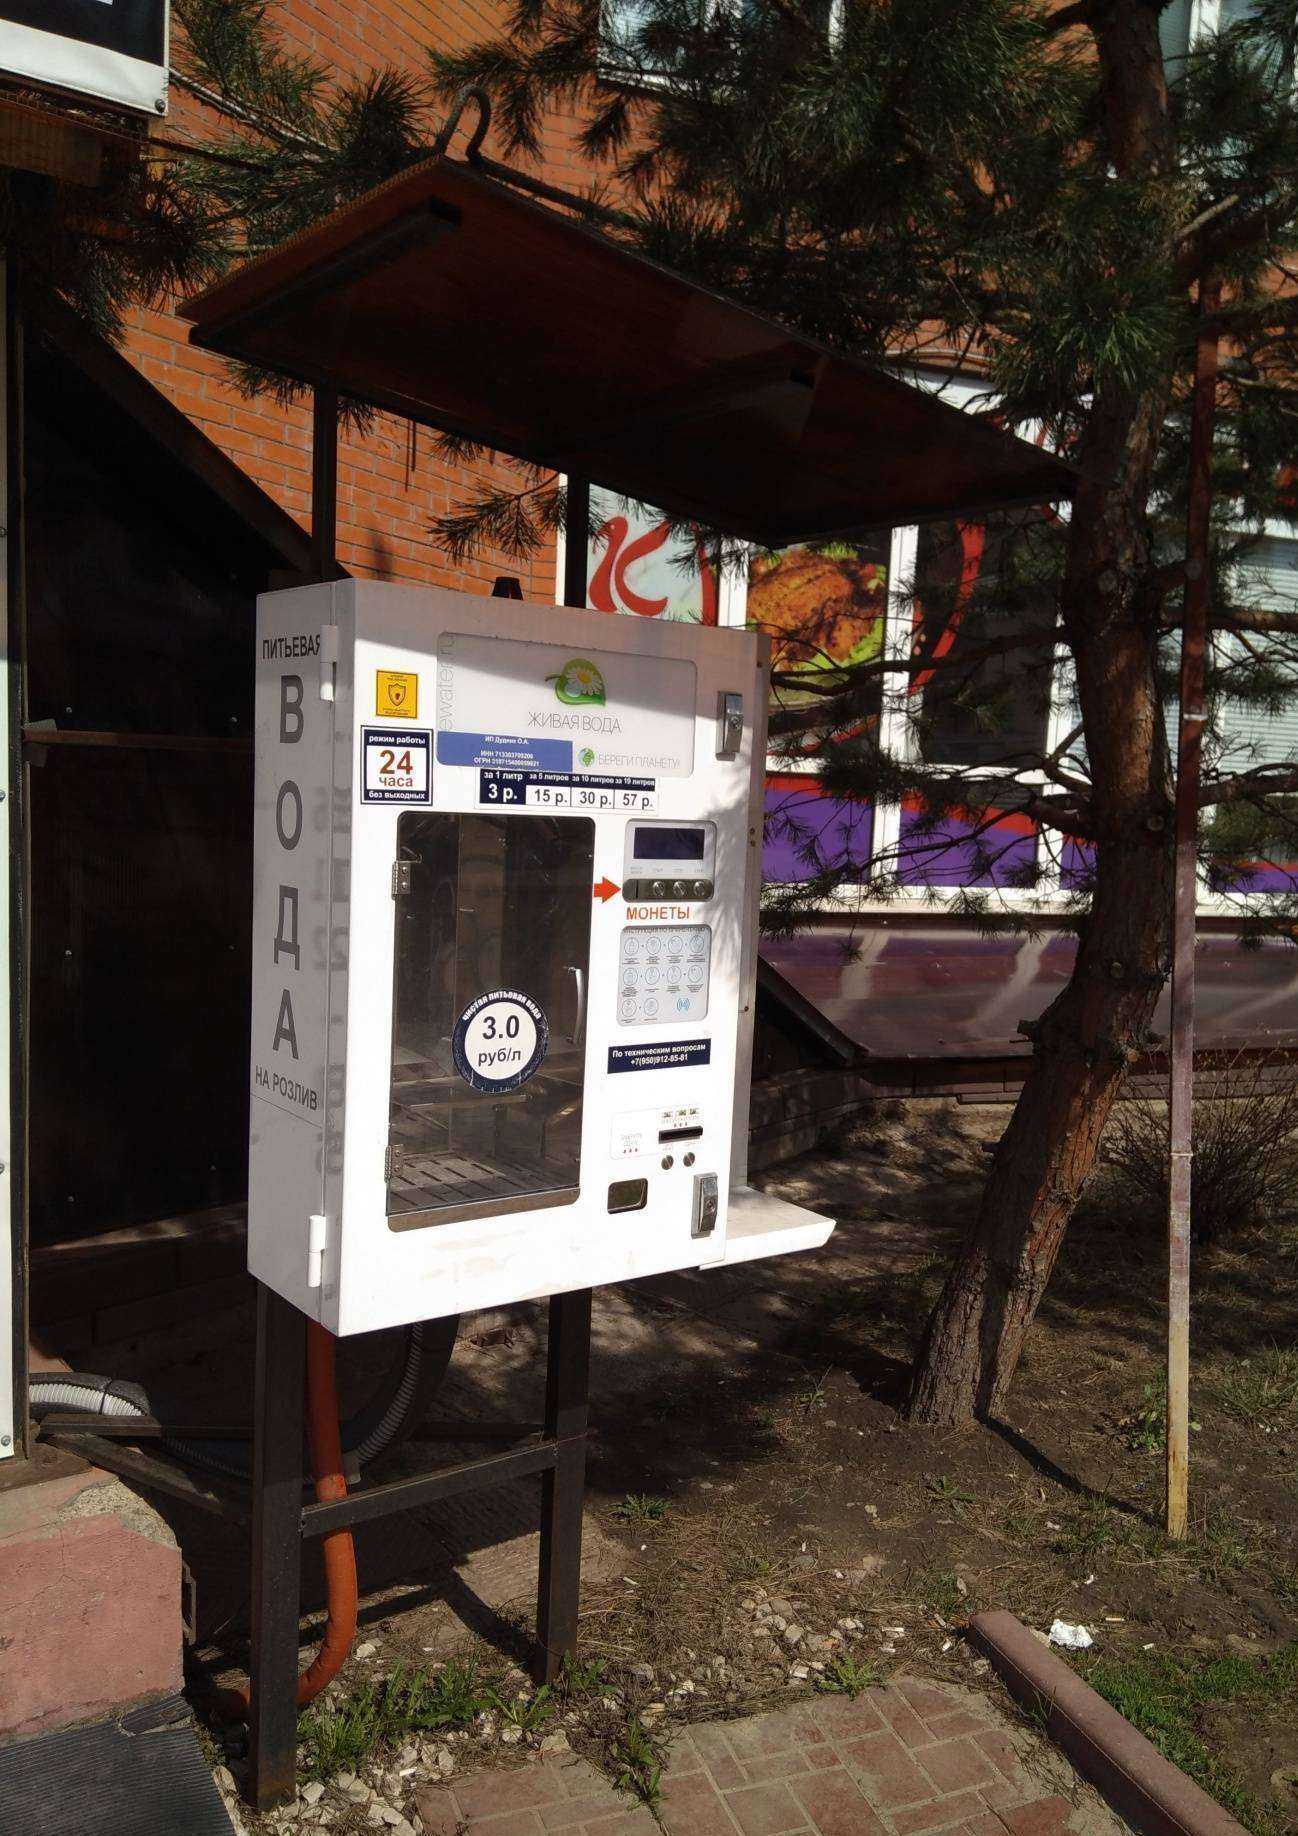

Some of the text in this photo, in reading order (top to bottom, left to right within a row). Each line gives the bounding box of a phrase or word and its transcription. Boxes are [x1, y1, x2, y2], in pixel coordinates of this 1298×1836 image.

[262, 634, 321, 660] ПИТЬЕВАЯ
[527, 711, 622, 735] ЖИВАЯ ВОДА
[368, 735, 426, 745] режим работы
[379, 749, 413, 775] 24
[379, 777, 413, 787] часа
[502, 772, 524, 781] литр
[544, 774, 569, 782] литров
[590, 776, 614, 785] литров
[624, 777, 631, 785] 19
[632, 778, 655, 787] литров
[368, 790, 426, 800] без выходных
[488, 783, 518, 802] 3 р.
[534, 788, 568, 806] 15 р.
[580, 790, 612, 808] 30 р.
[622, 793, 653, 810] 57 р.
[272, 675, 304, 1060] ВОДА
[626, 906, 690, 920] МОНЕТЫ
[488, 990, 528, 1004] питьевая
[525, 1000, 542, 1020] вода
[482, 1014, 520, 1040] 3.0
[478, 1047, 522, 1067] руб/л
[612, 1044, 706, 1058] По техническим вопросам
[255, 1065, 319, 1111] НА РОЗЛИВ
